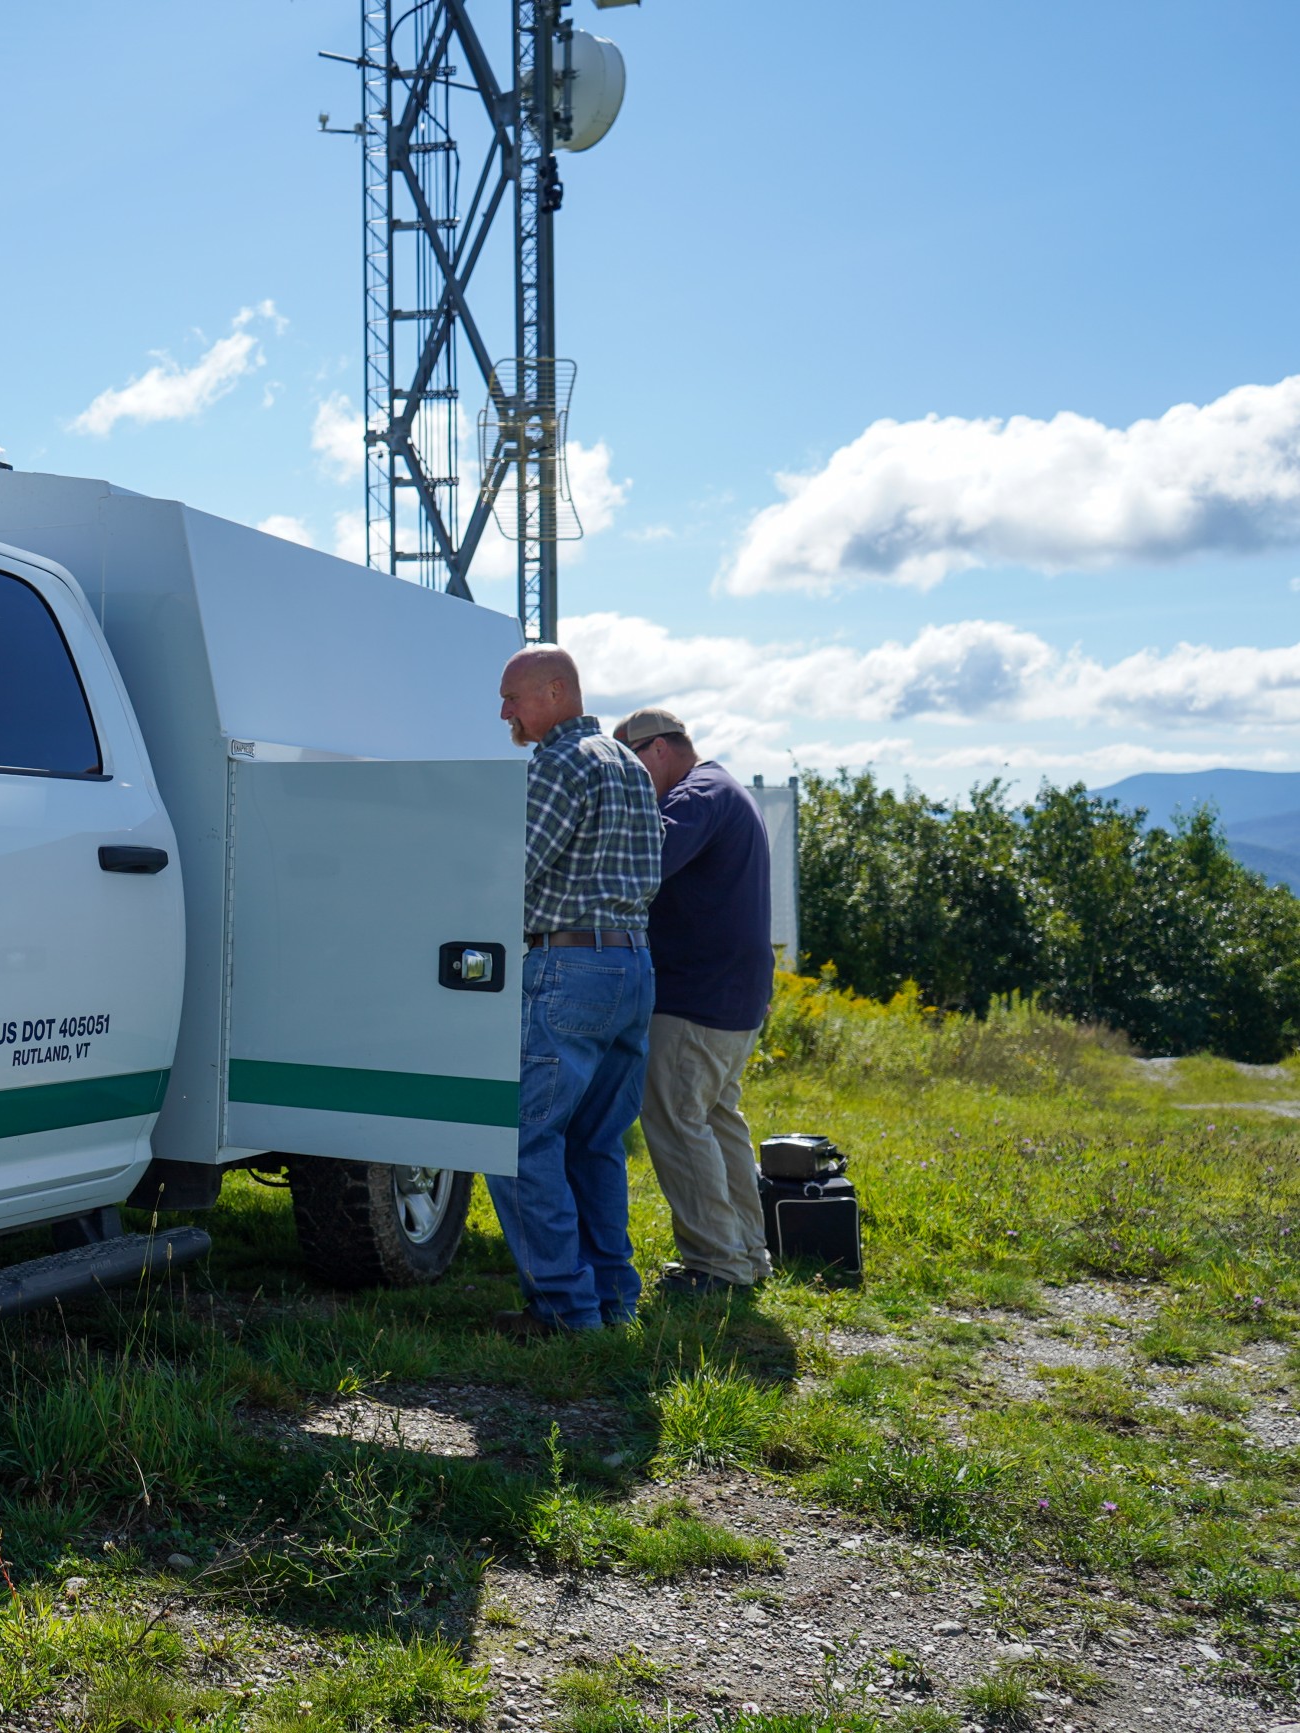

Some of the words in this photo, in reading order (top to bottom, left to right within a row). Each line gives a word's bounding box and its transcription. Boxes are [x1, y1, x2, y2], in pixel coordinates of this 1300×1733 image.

[22, 1019, 56, 1042] DOT
[59, 1014, 110, 1038] 405051
[12, 1044, 72, 1066] RUTLAND,
[76, 1042, 91, 1058] VT
